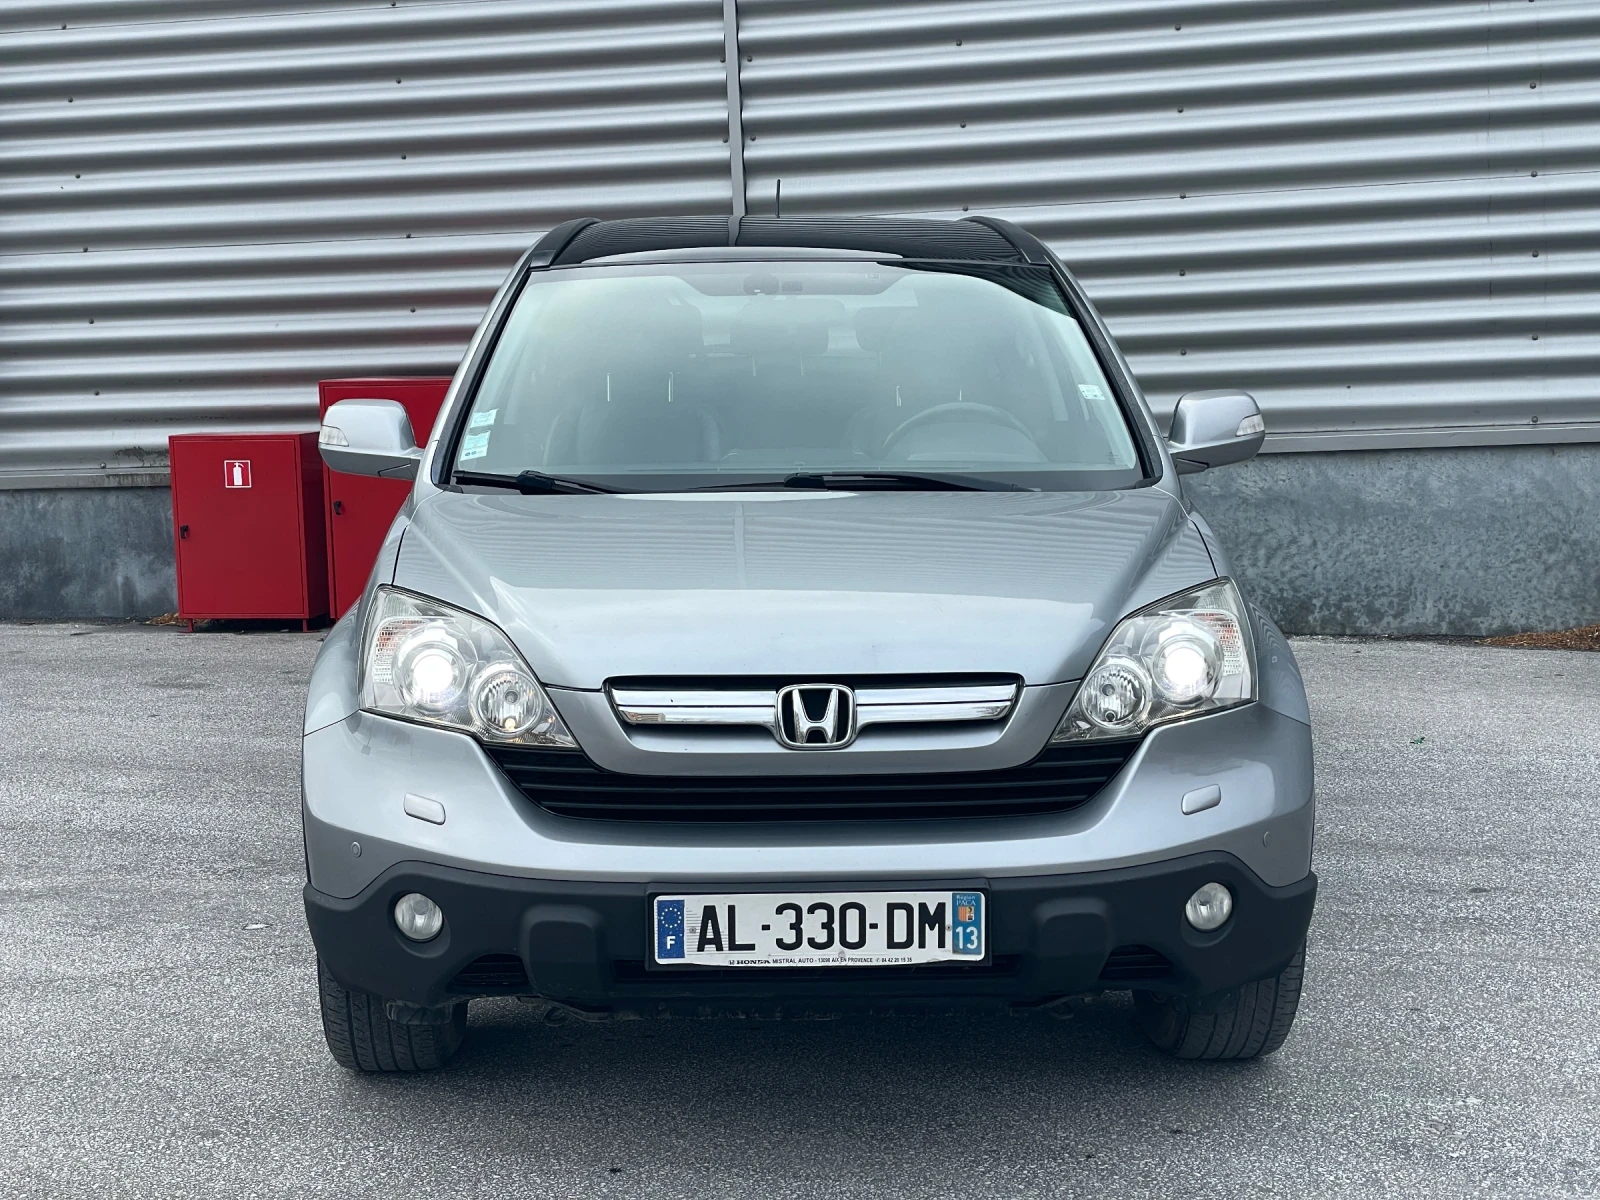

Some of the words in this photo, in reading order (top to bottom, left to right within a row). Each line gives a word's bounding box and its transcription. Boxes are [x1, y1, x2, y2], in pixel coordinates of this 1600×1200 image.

[696, 901, 946, 952] AL-330-DM
[955, 926, 978, 950] 13
[666, 935, 676, 950] F
